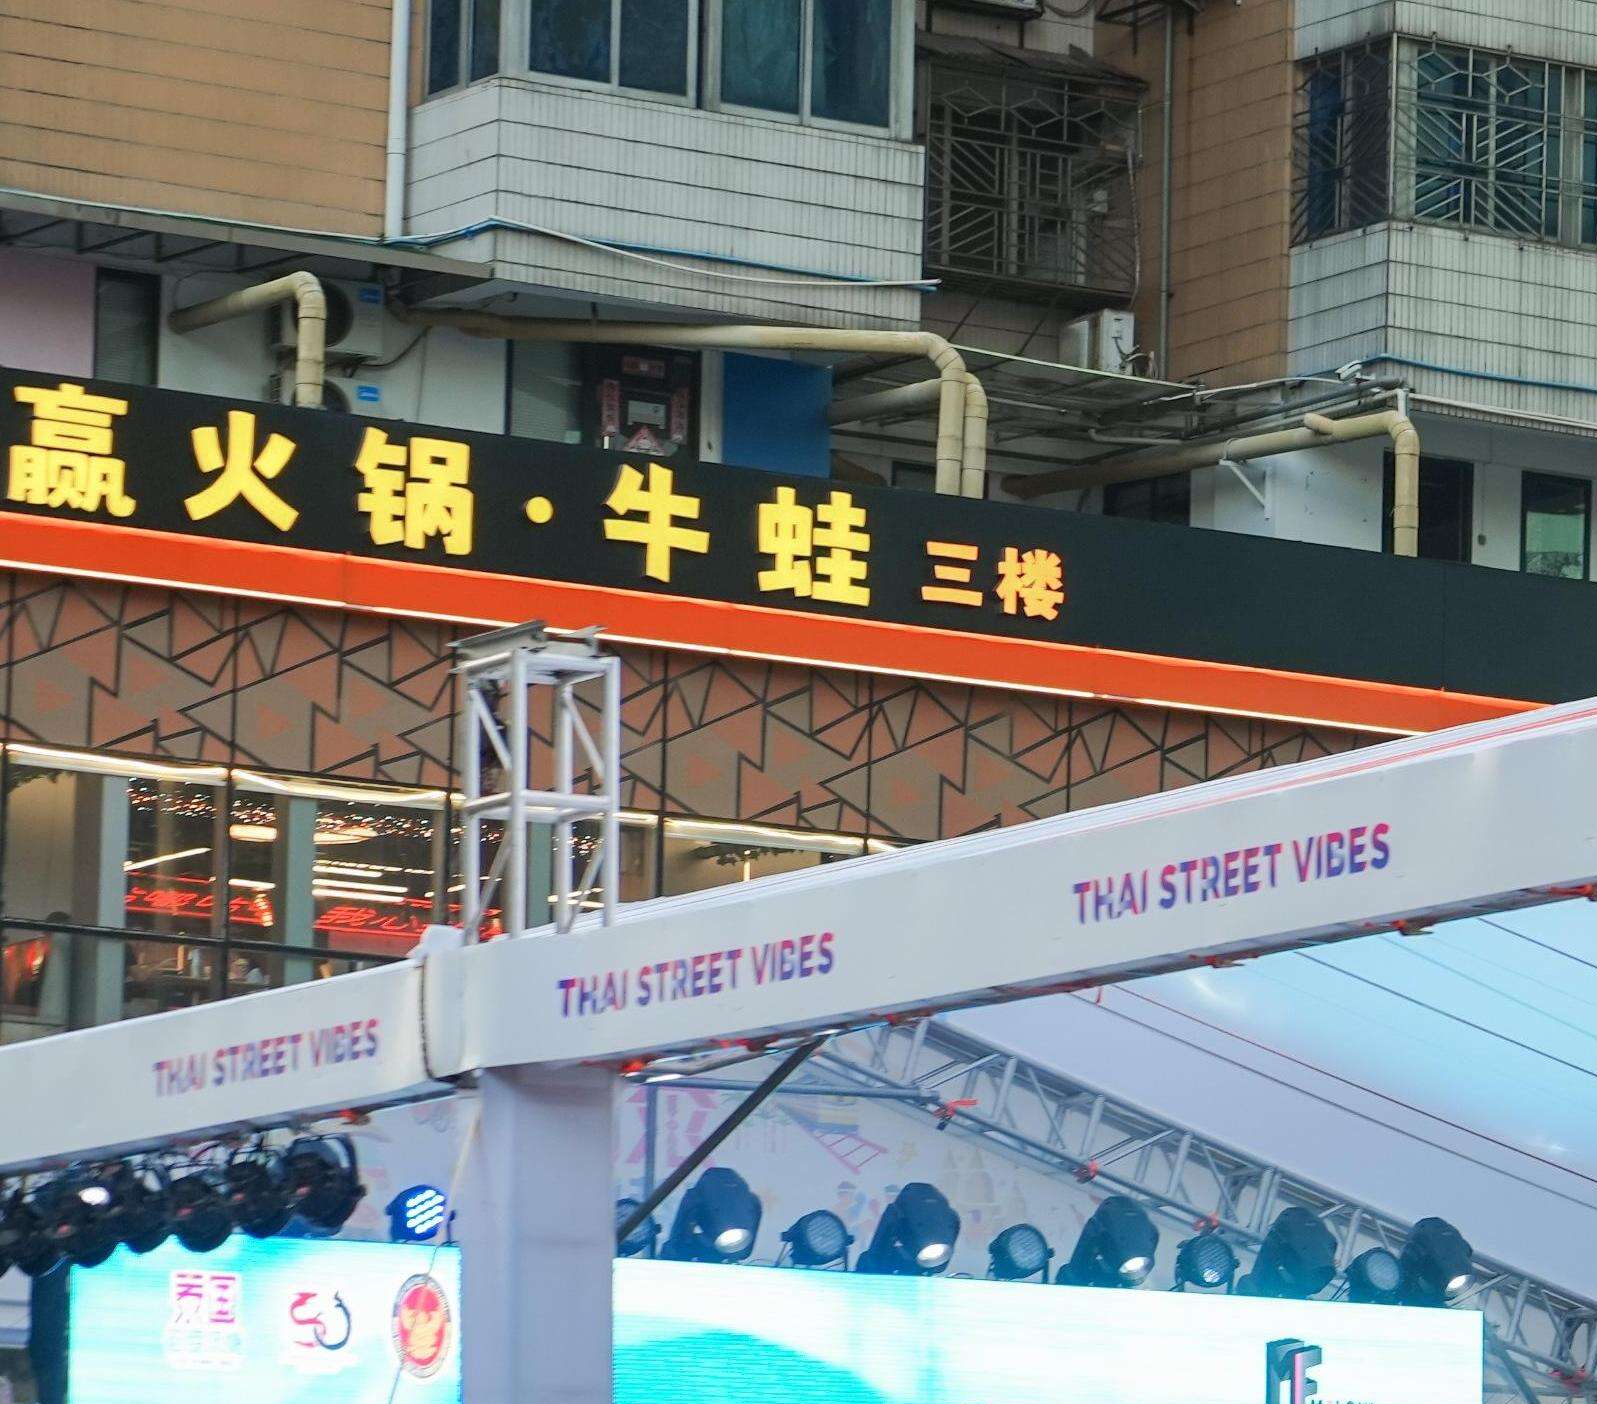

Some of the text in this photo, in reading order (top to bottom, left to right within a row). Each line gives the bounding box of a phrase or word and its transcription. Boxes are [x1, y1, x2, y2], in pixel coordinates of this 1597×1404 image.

[6, 383, 1065, 620] 赢火锅·牛蛙 三楼
[1073, 822, 1391, 924] THAI STREET VIBES
[557, 931, 835, 1018] THAI STREET VIBES
[154, 1017, 380, 1098] THAI STREET VIBES
